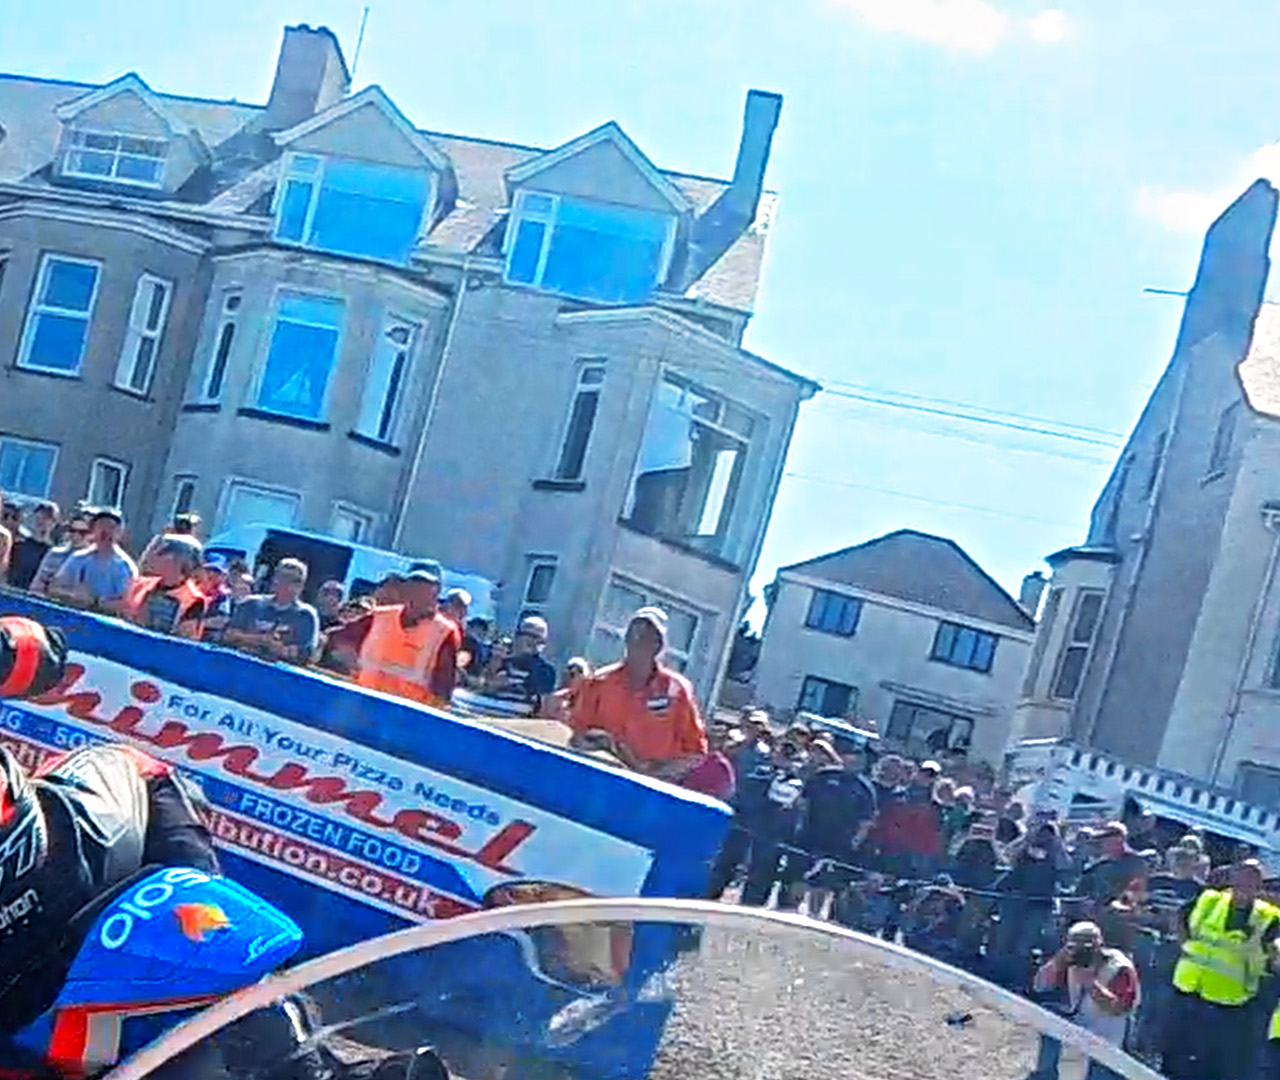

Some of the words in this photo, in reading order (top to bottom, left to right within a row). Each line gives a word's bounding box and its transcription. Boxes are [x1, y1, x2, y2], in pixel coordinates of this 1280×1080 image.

[30, 664, 537, 876] himmel
[166, 693, 212, 721] For
[219, 710, 255, 738] All
[264, 731, 326, 763] Your
[331, 752, 405, 792] Pizza
[413, 782, 501, 827] Needs
[239, 794, 344, 848] FROZEN
[347, 830, 421, 876] FOOD
